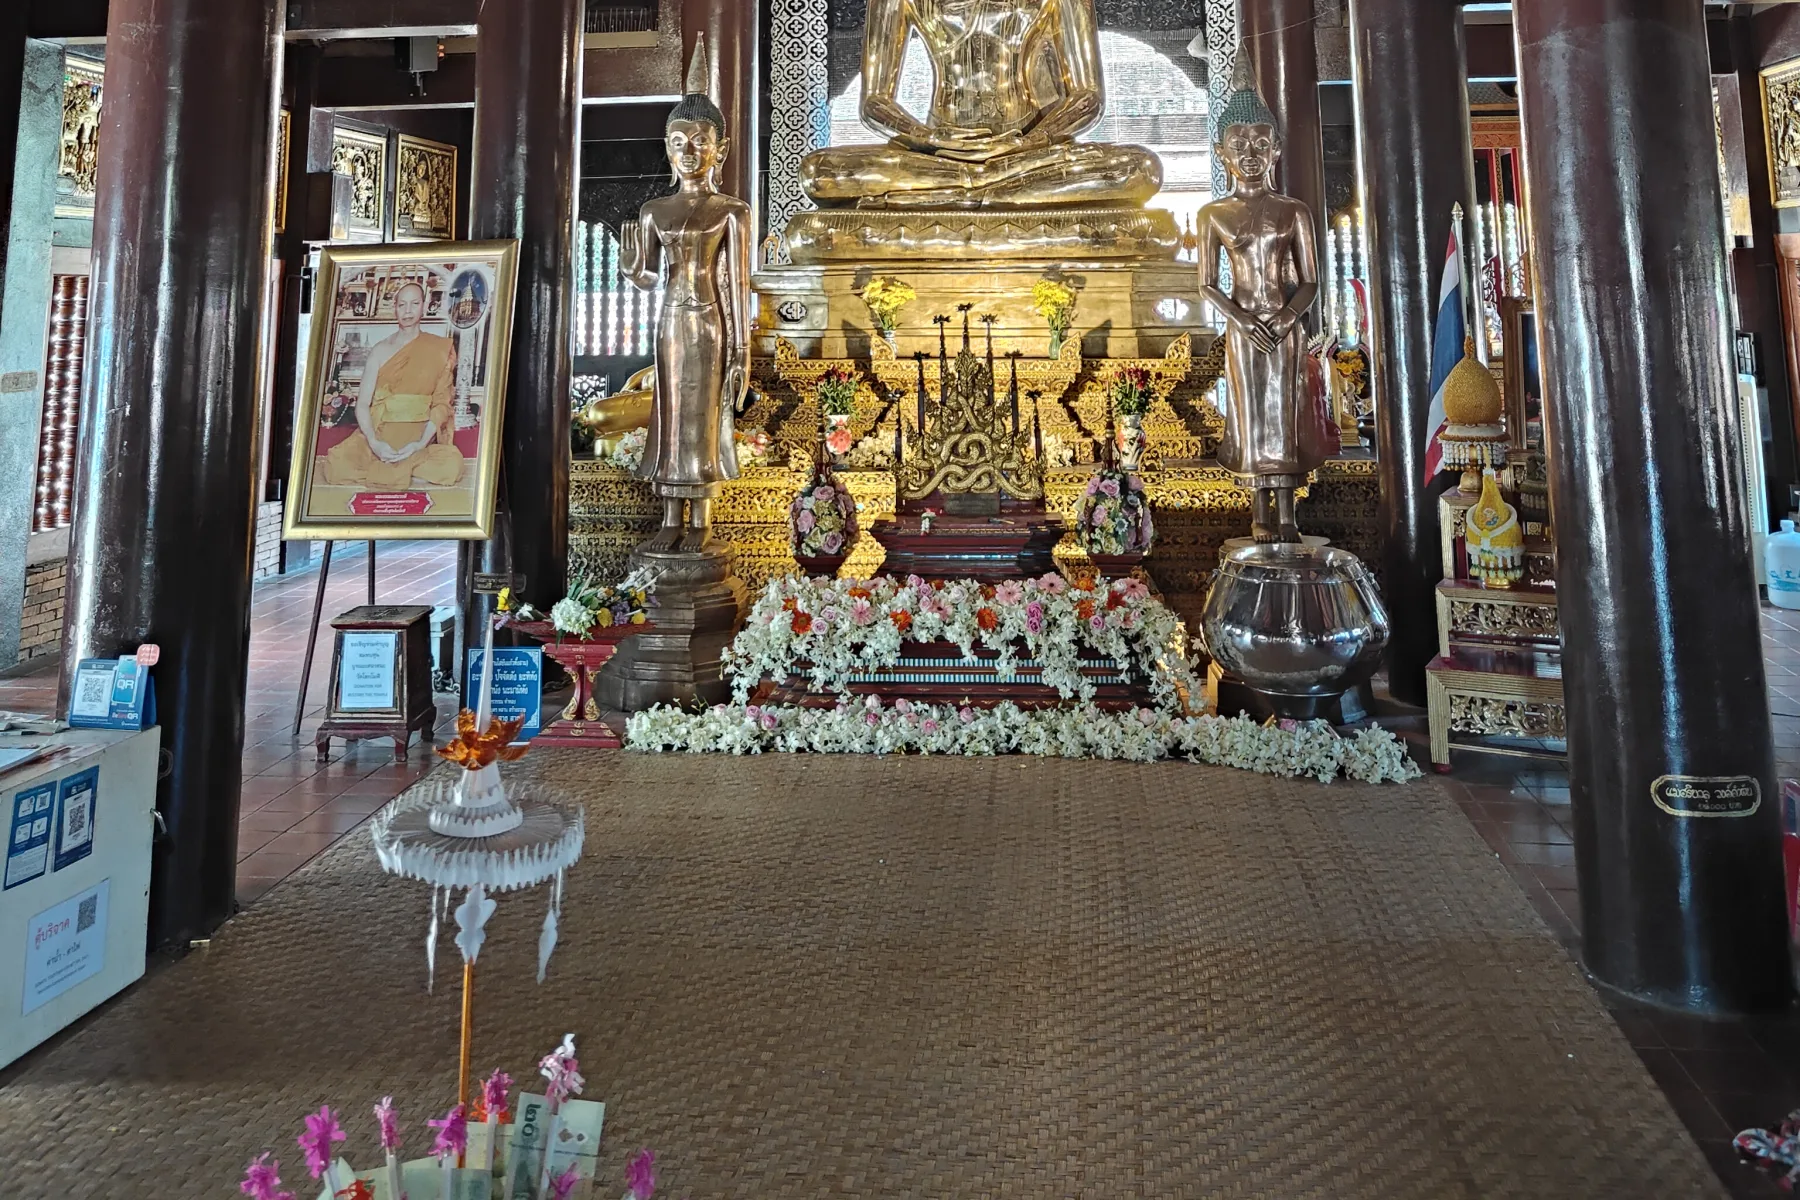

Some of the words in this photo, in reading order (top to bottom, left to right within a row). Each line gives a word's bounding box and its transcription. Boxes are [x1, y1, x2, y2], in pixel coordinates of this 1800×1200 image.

[117, 679, 134, 690] QR
[35, 918, 70, 950] ตู้บริจาค
